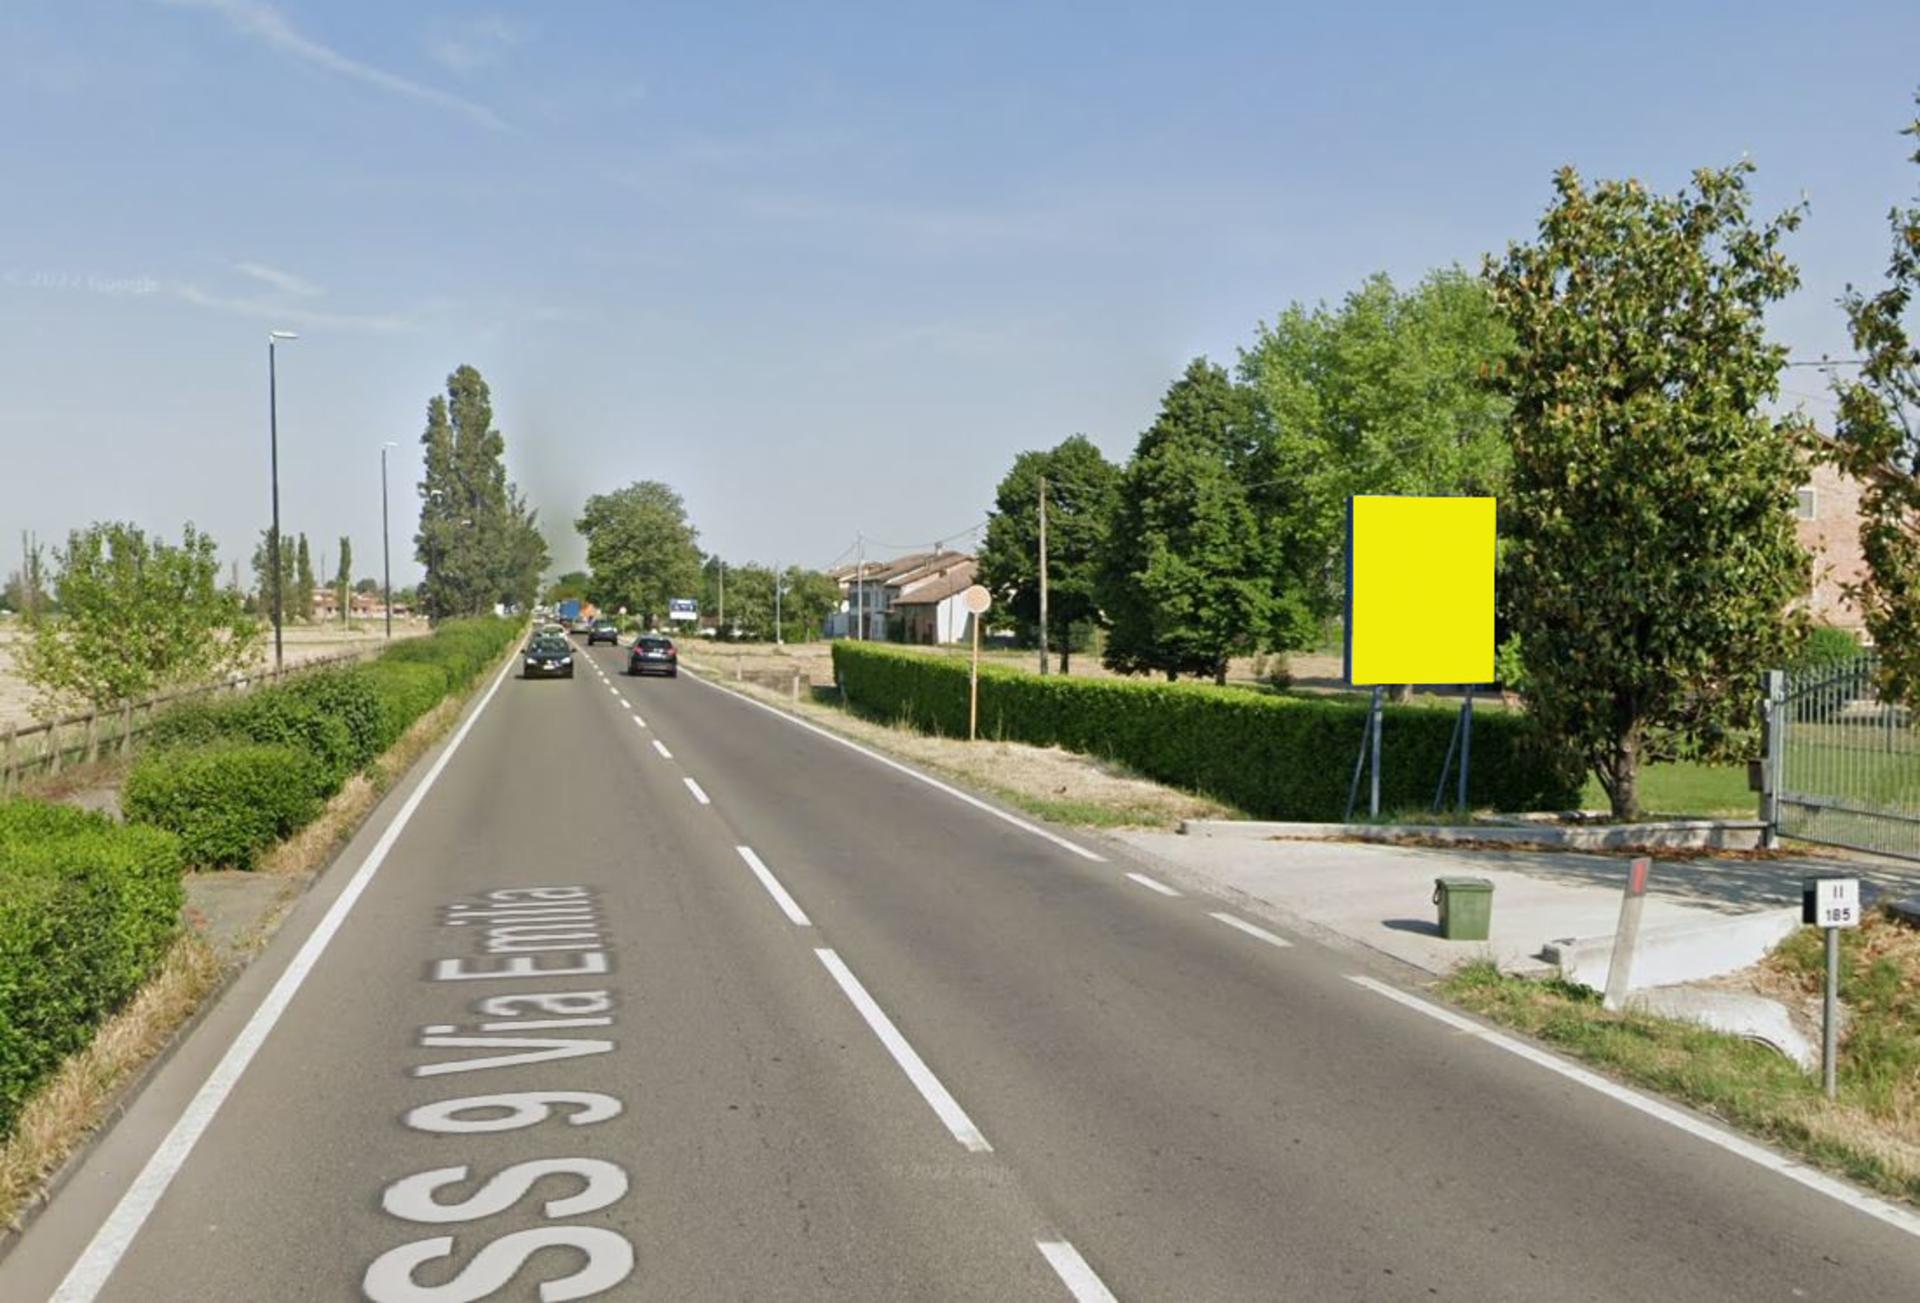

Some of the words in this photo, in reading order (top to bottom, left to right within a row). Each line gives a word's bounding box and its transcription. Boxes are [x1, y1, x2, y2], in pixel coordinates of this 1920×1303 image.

[434, 886, 609, 981] Emilia
[1826, 908, 1851, 921] 185
[413, 990, 614, 1077] Via
[404, 1091, 623, 1133] 9
[363, 1157, 635, 1303] SS
